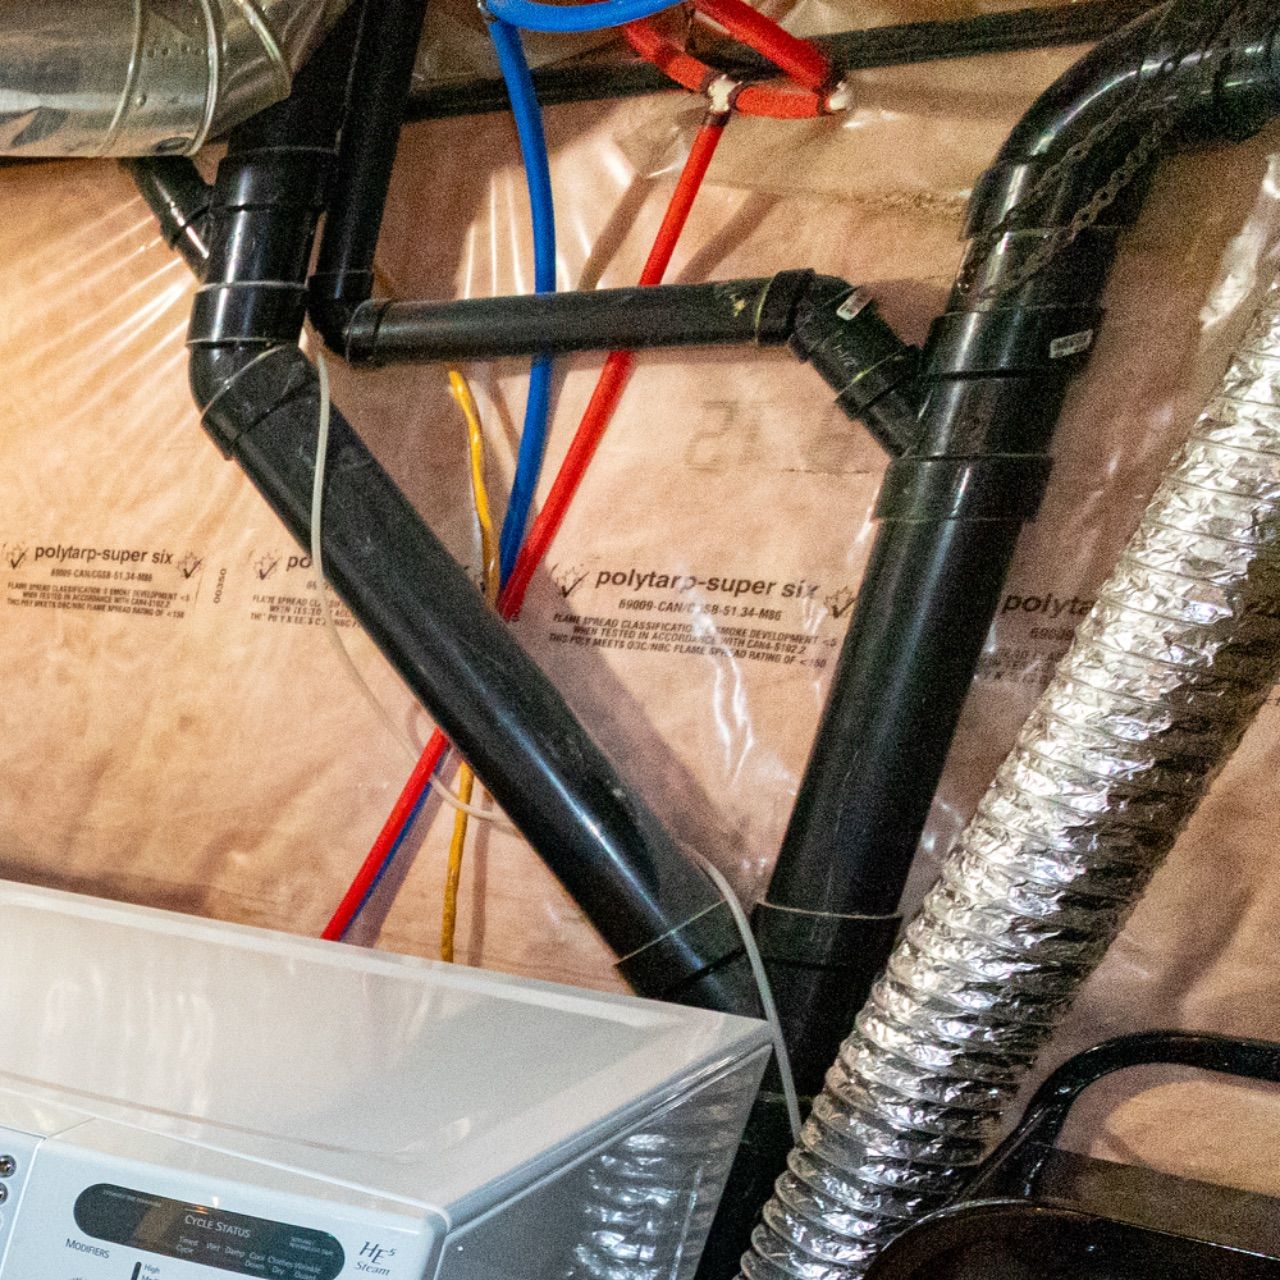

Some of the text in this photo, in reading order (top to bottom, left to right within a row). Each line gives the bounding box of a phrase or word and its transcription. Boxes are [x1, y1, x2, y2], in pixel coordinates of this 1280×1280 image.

[34, 544, 174, 565] polytarp-super six
[595, 568, 821, 600] polytarp-super six
[600, 627, 635, 639] TESTED
[620, 619, 695, 632] CLASSIFICATIO
[749, 628, 819, 645] DEVELOPMENT
[184, 1214, 252, 1240] CYCLE STATUS
[64, 1238, 111, 1260] MODIFIERS
[143, 1263, 161, 1275] High
[354, 1260, 392, 1277] Steam
